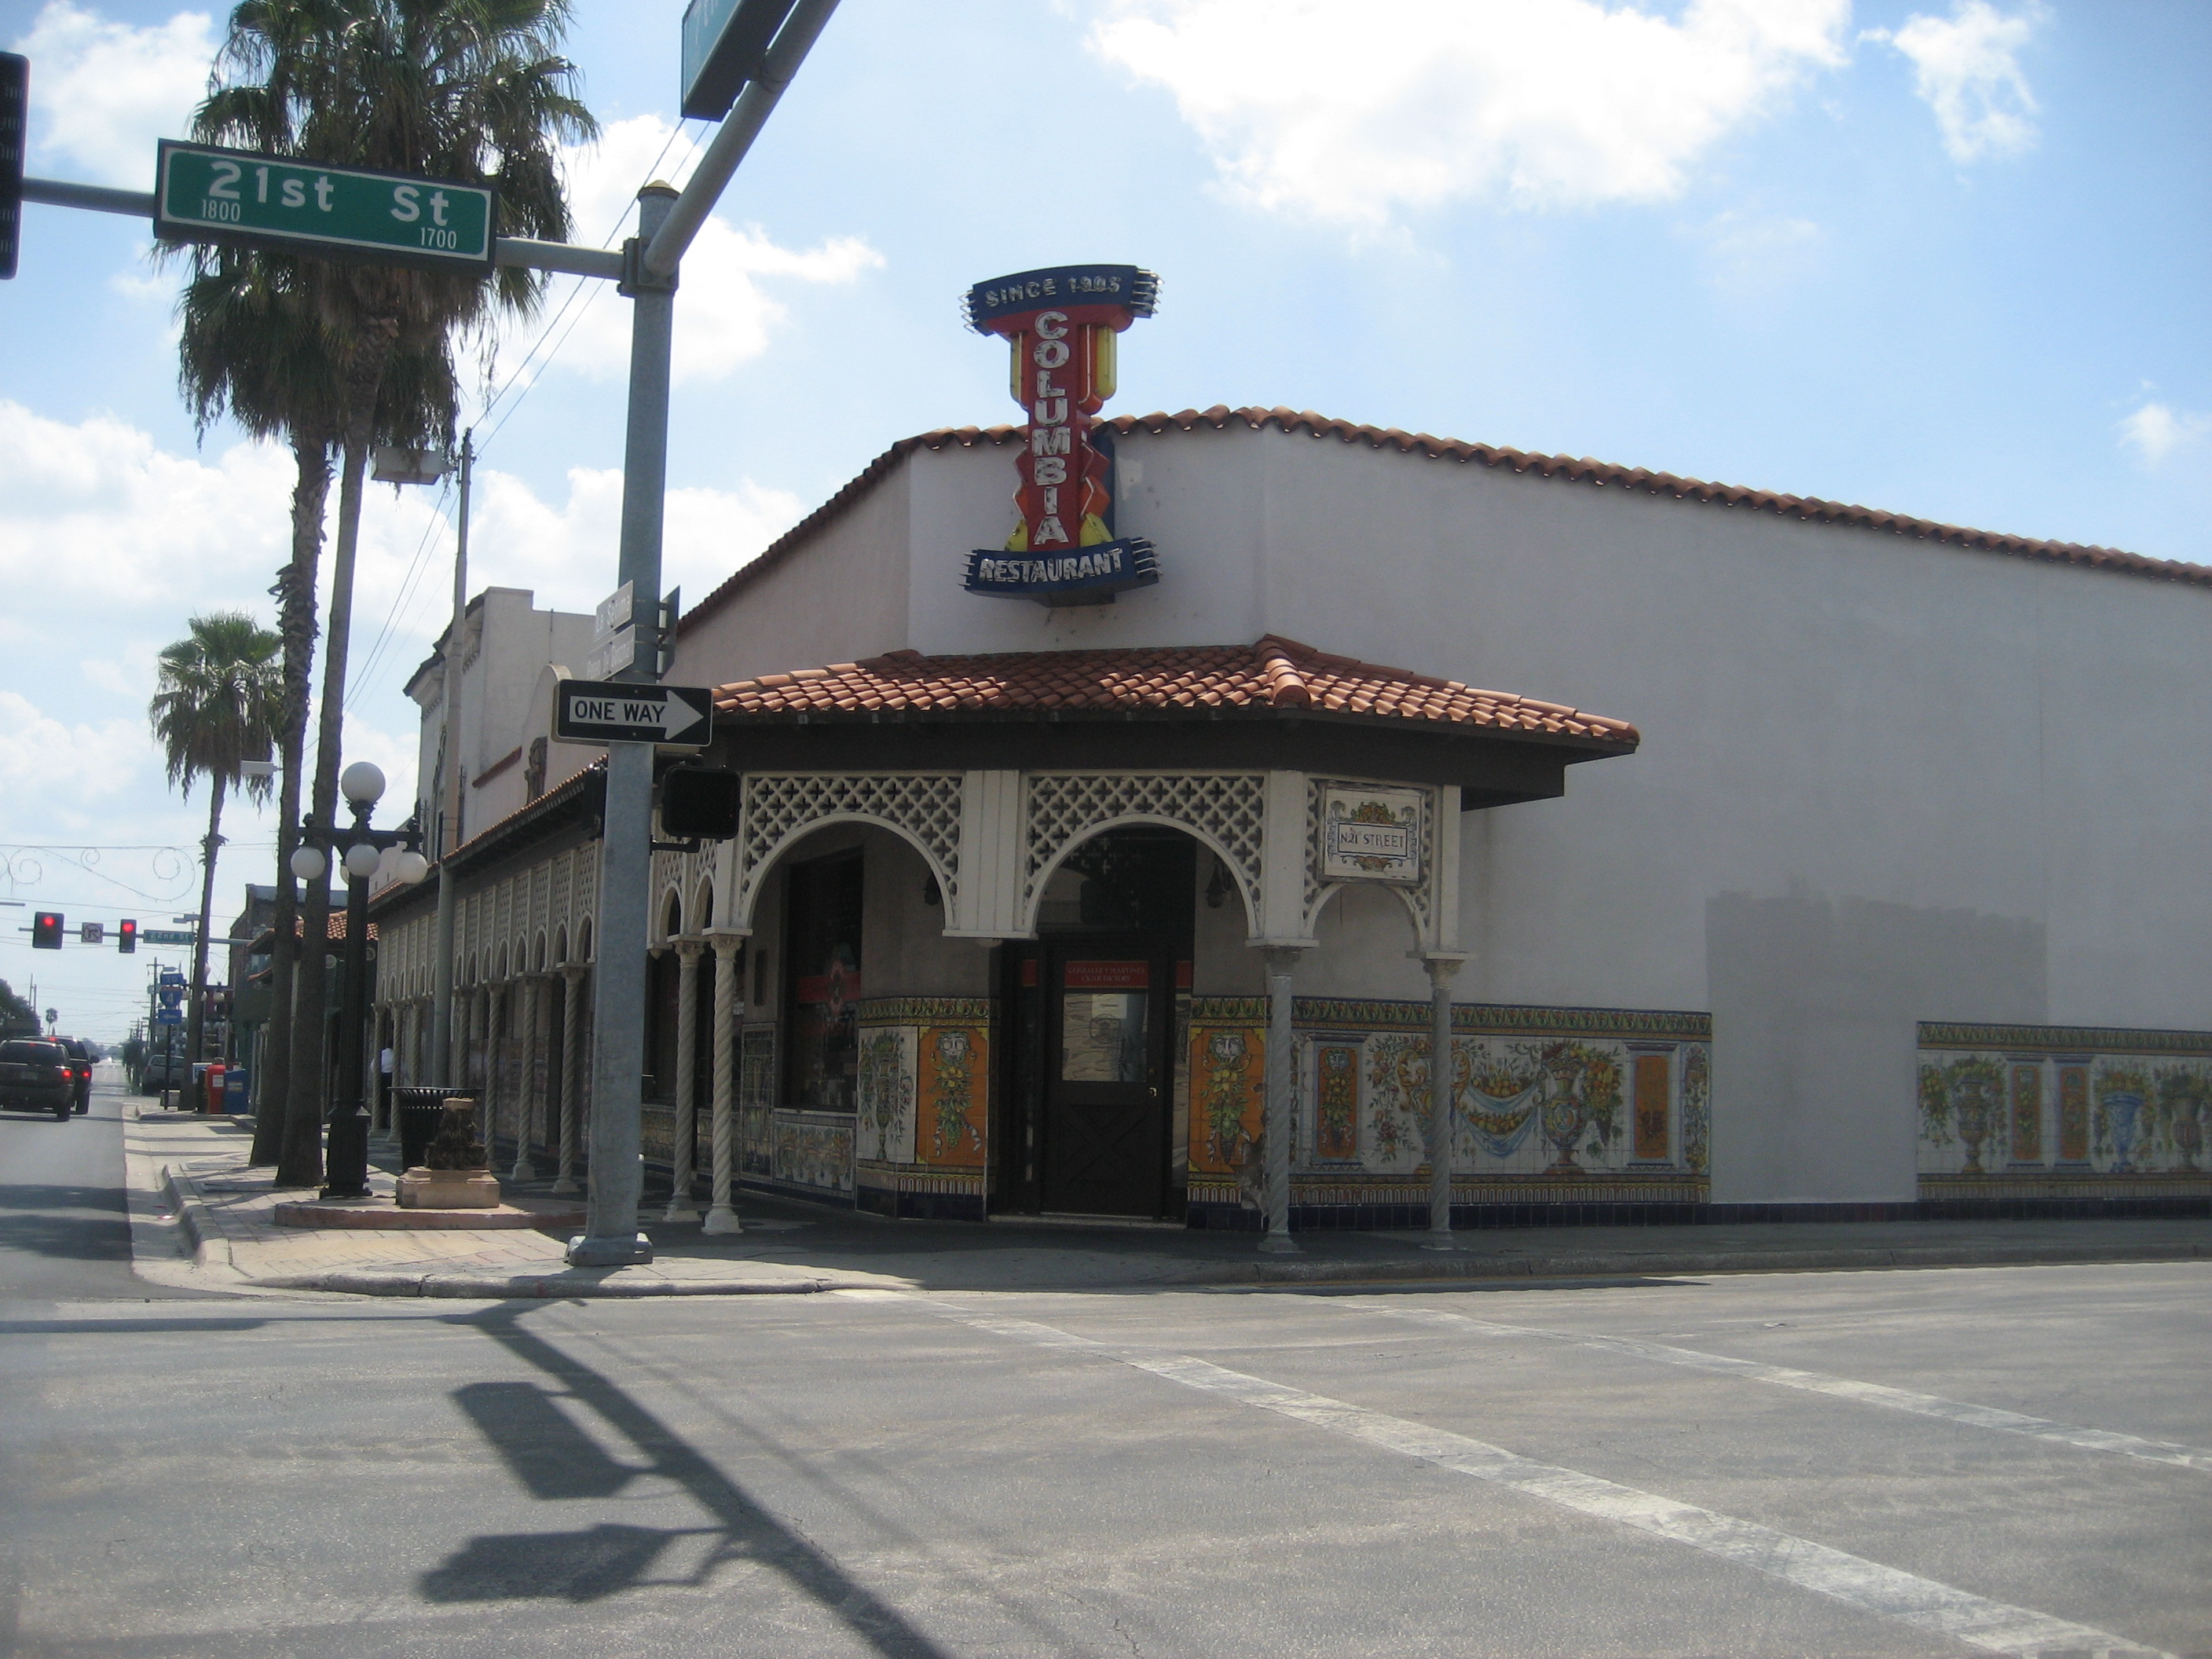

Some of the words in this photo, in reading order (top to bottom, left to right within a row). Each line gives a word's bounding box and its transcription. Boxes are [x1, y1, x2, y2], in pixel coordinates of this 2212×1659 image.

[209, 160, 335, 211] 21st
[390, 184, 449, 226] St
[201, 198, 240, 222] 1800
[421, 226, 456, 250] 1700
[985, 277, 1057, 307] SINCE
[1068, 276, 1122, 293] 1905
[1032, 310, 1071, 545] COLUMBIA
[979, 548, 1123, 582] RESTAURANT
[574, 700, 615, 721] ONE
[624, 704, 665, 723] WAY
[1364, 833, 1404, 848] STREET
[166, 992, 174, 1003] 4
